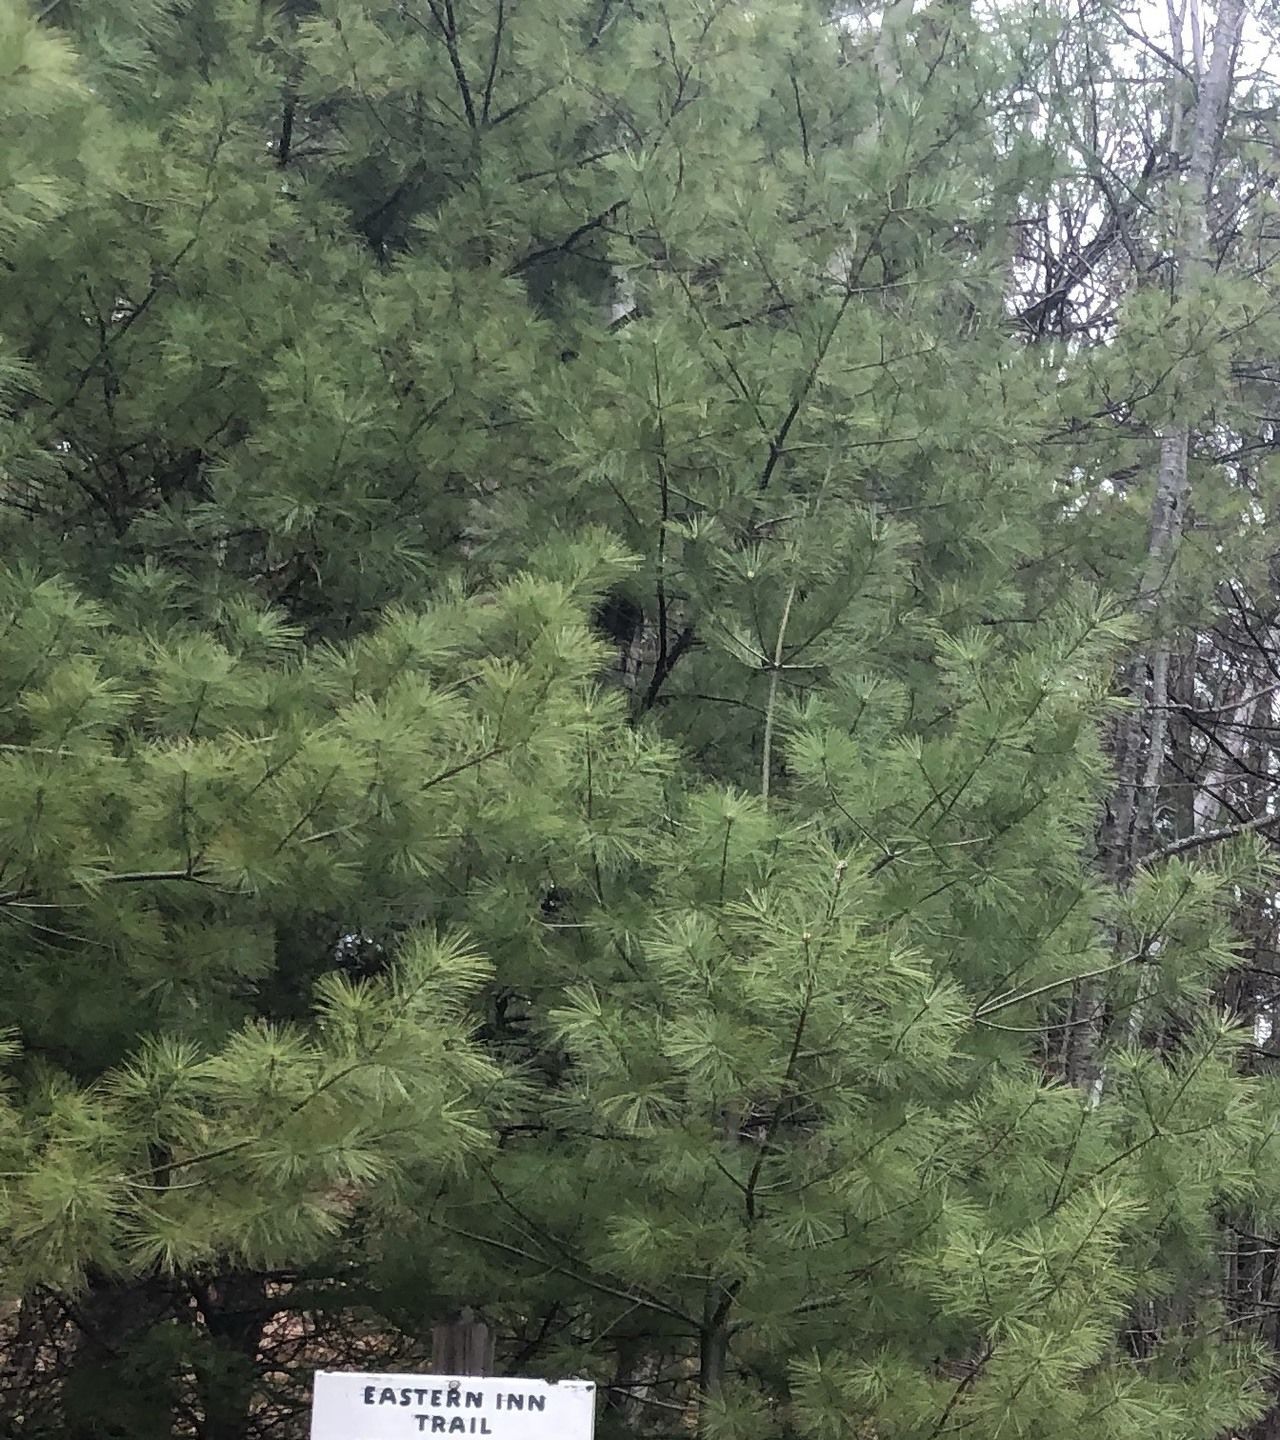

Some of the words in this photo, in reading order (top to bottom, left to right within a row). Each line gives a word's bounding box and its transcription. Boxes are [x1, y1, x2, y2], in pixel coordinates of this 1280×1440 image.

[364, 1385, 484, 1409] EASTERN
[496, 1393, 546, 1411] INN
[415, 1414, 492, 1435] TRAIL
